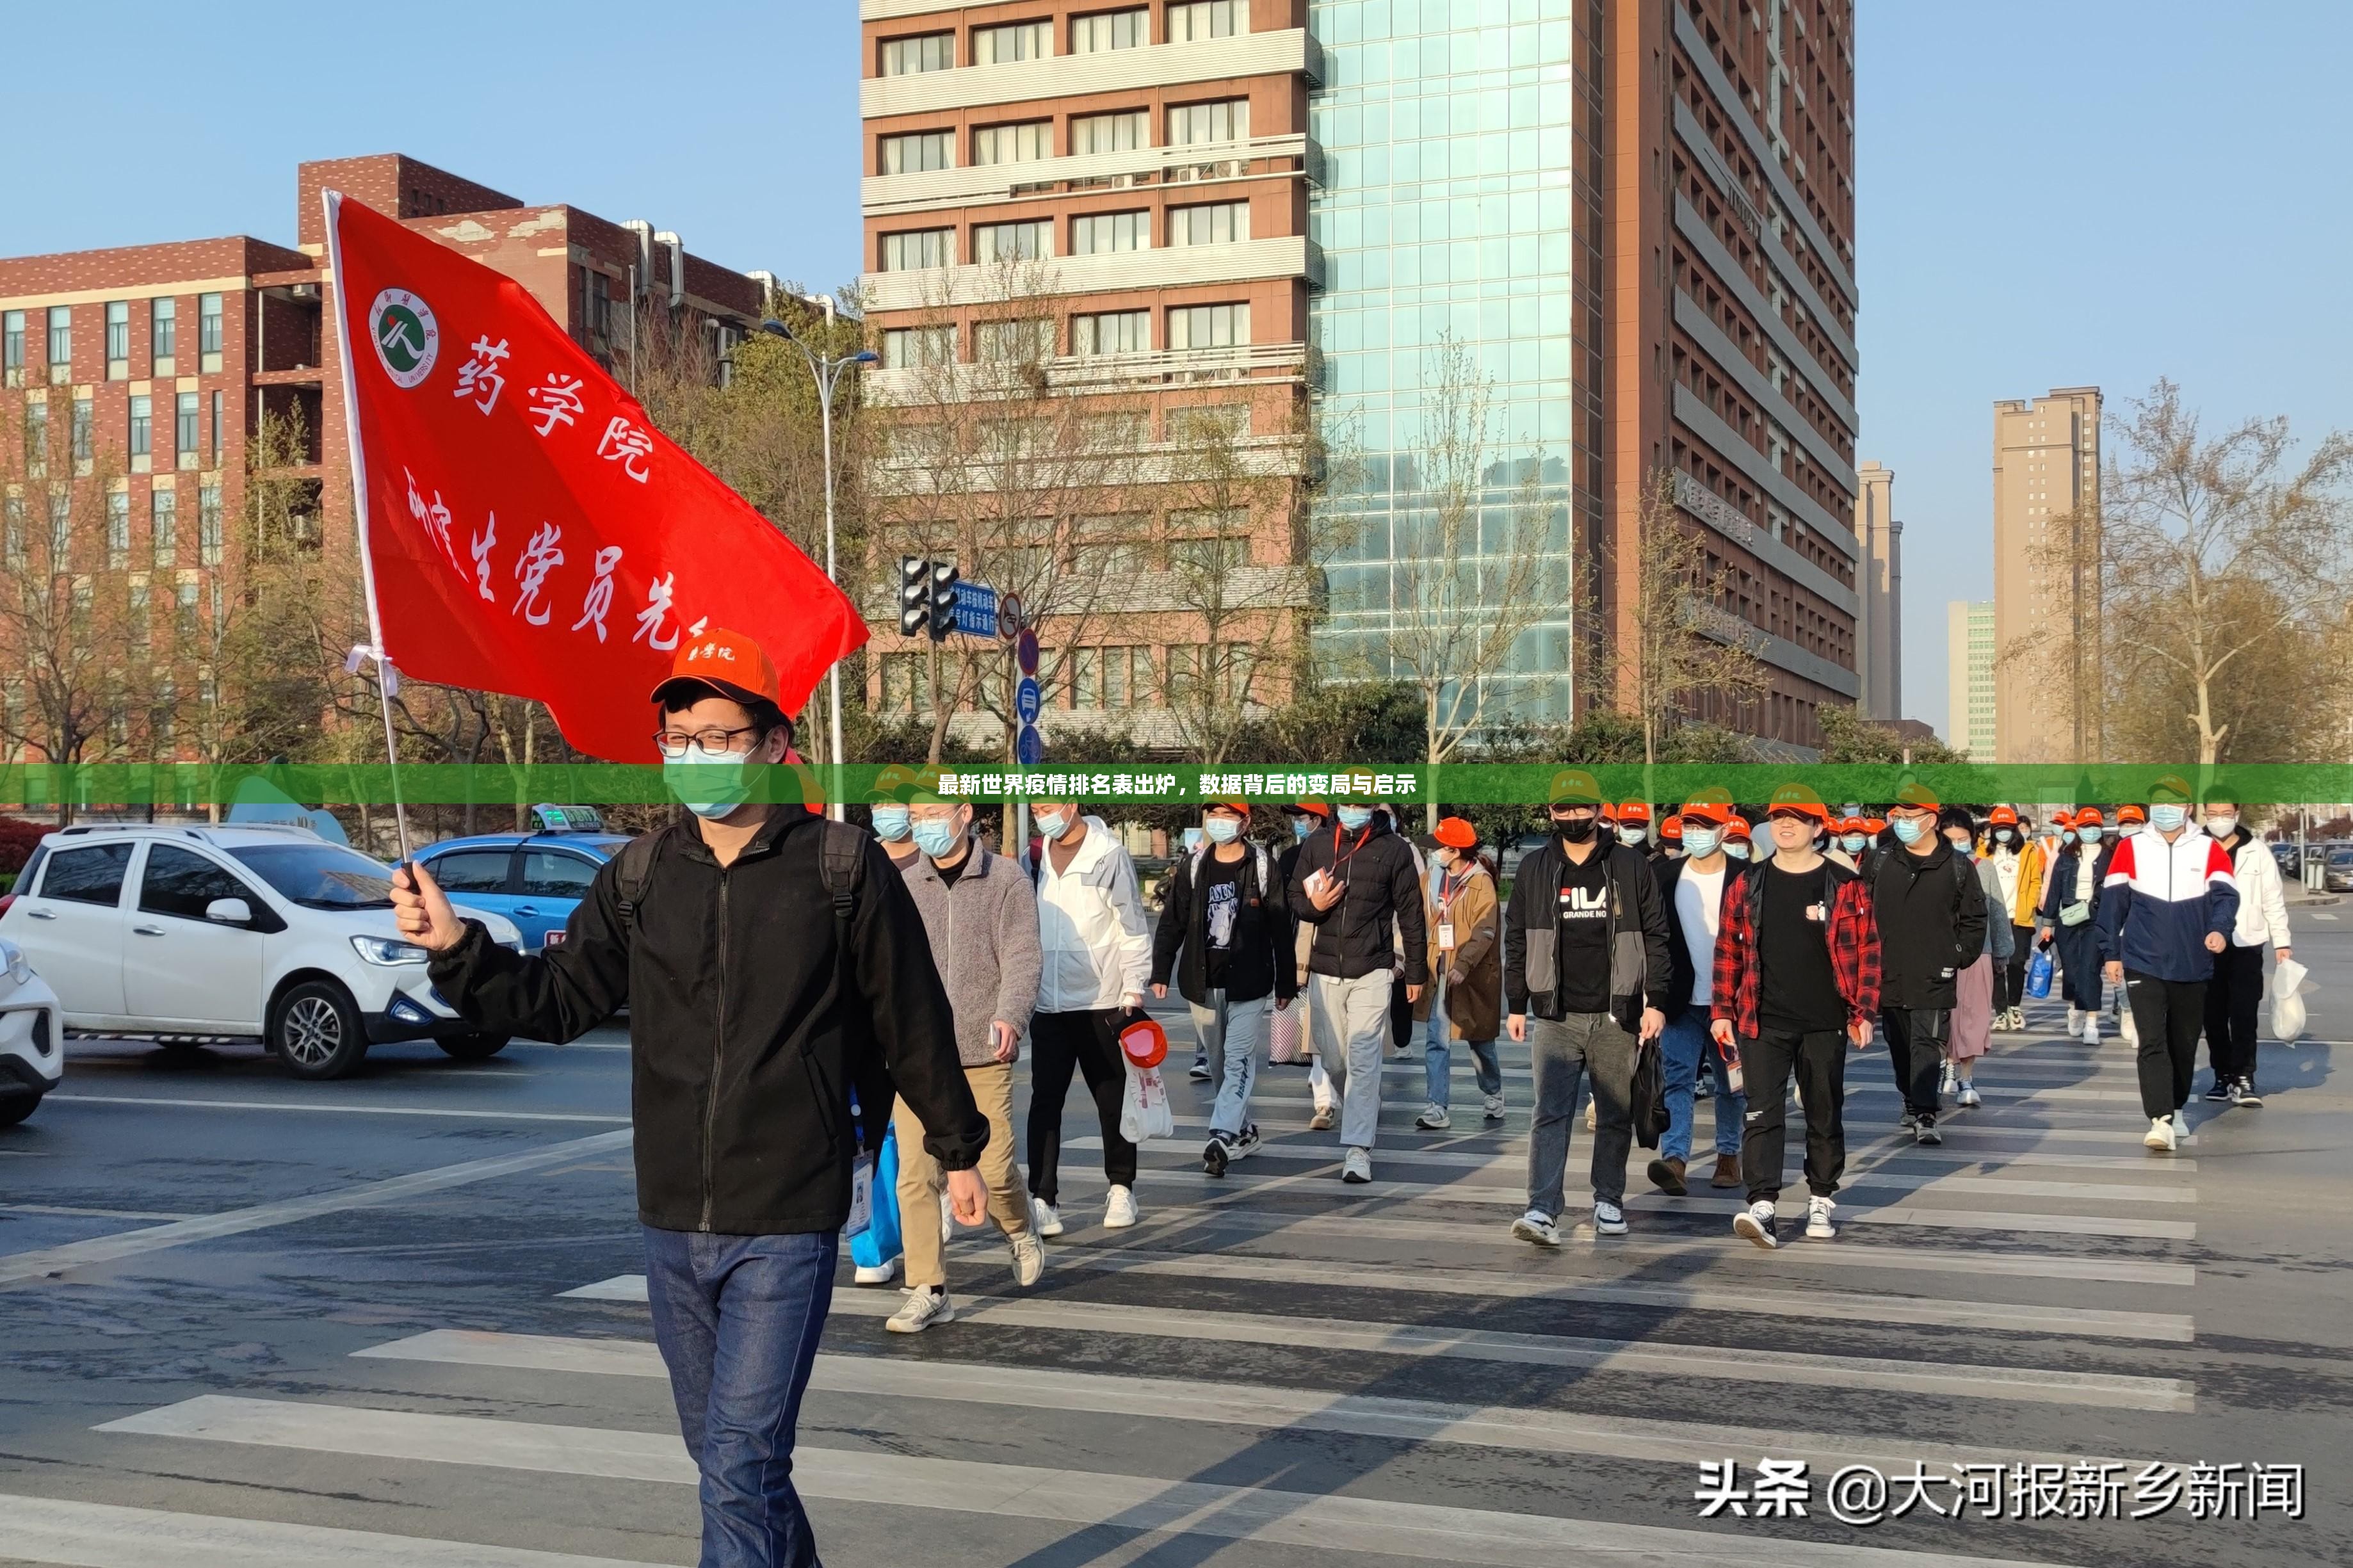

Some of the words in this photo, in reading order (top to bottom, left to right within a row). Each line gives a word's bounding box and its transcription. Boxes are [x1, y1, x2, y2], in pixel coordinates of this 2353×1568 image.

[408, 353, 434, 383] UNIVERSITY
[453, 334, 654, 484] 药学院
[949, 585, 994, 612] 机动车按机动车
[1563, 910, 1595, 919] GRANDE
